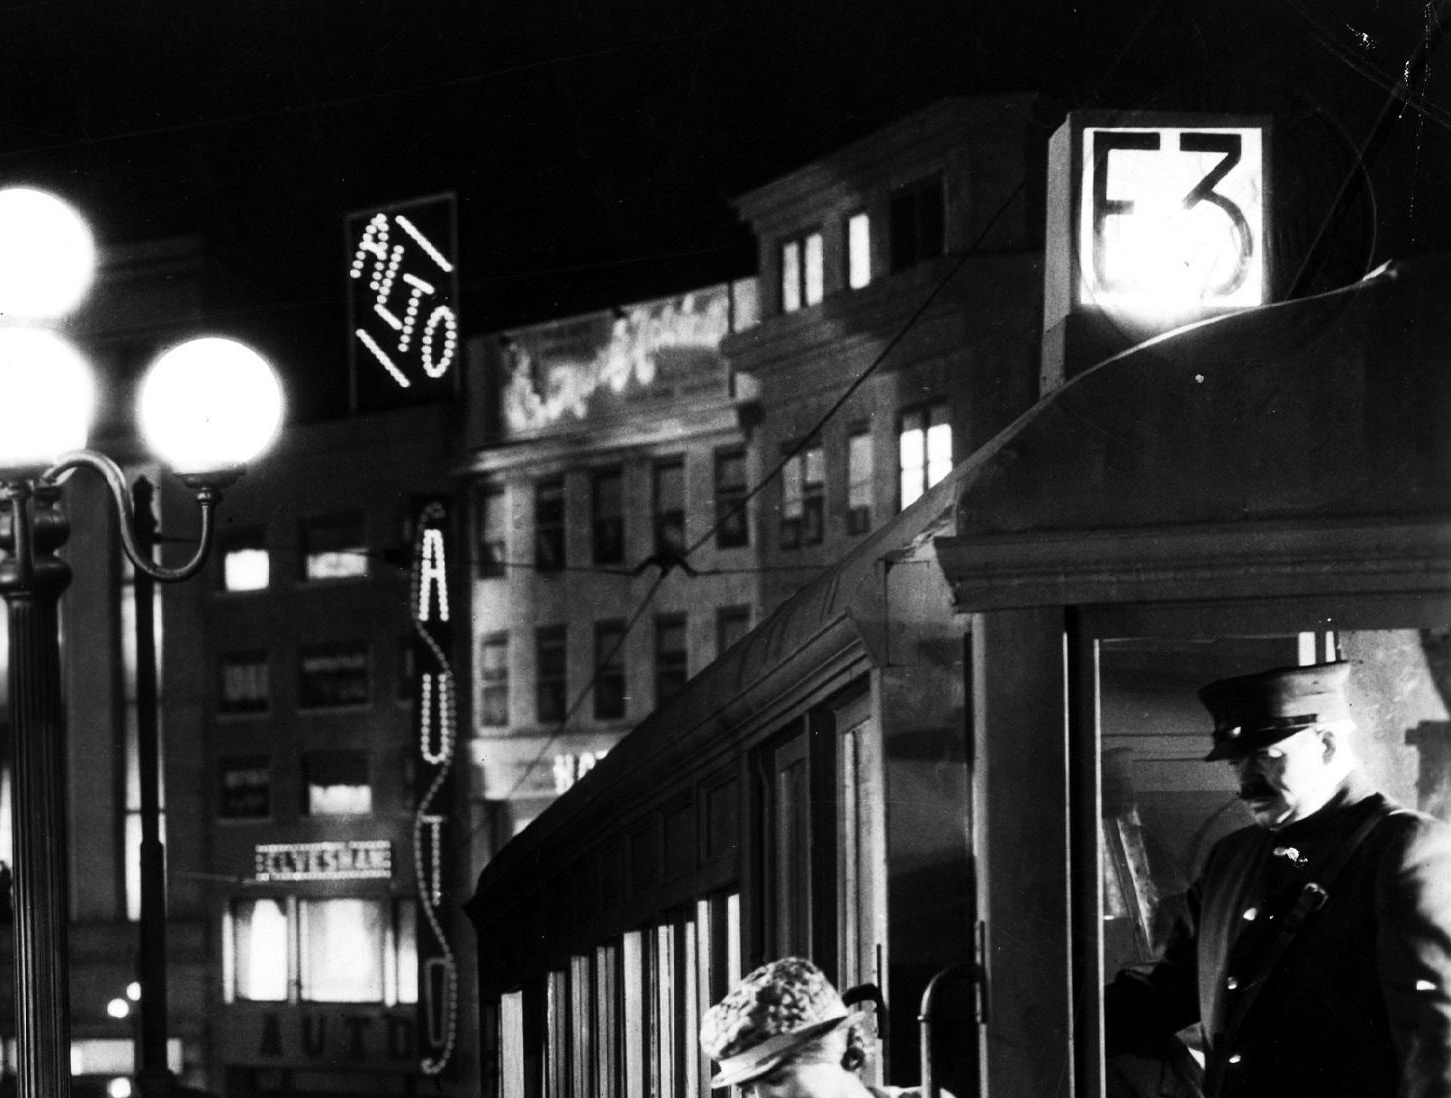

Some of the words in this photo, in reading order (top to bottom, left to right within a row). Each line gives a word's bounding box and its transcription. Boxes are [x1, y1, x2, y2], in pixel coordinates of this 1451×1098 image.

[350, 213, 457, 377] ALTO
[1093, 131, 1254, 296] E3
[418, 528, 450, 1048] AUTO
[259, 1012, 414, 1060] AUTO
